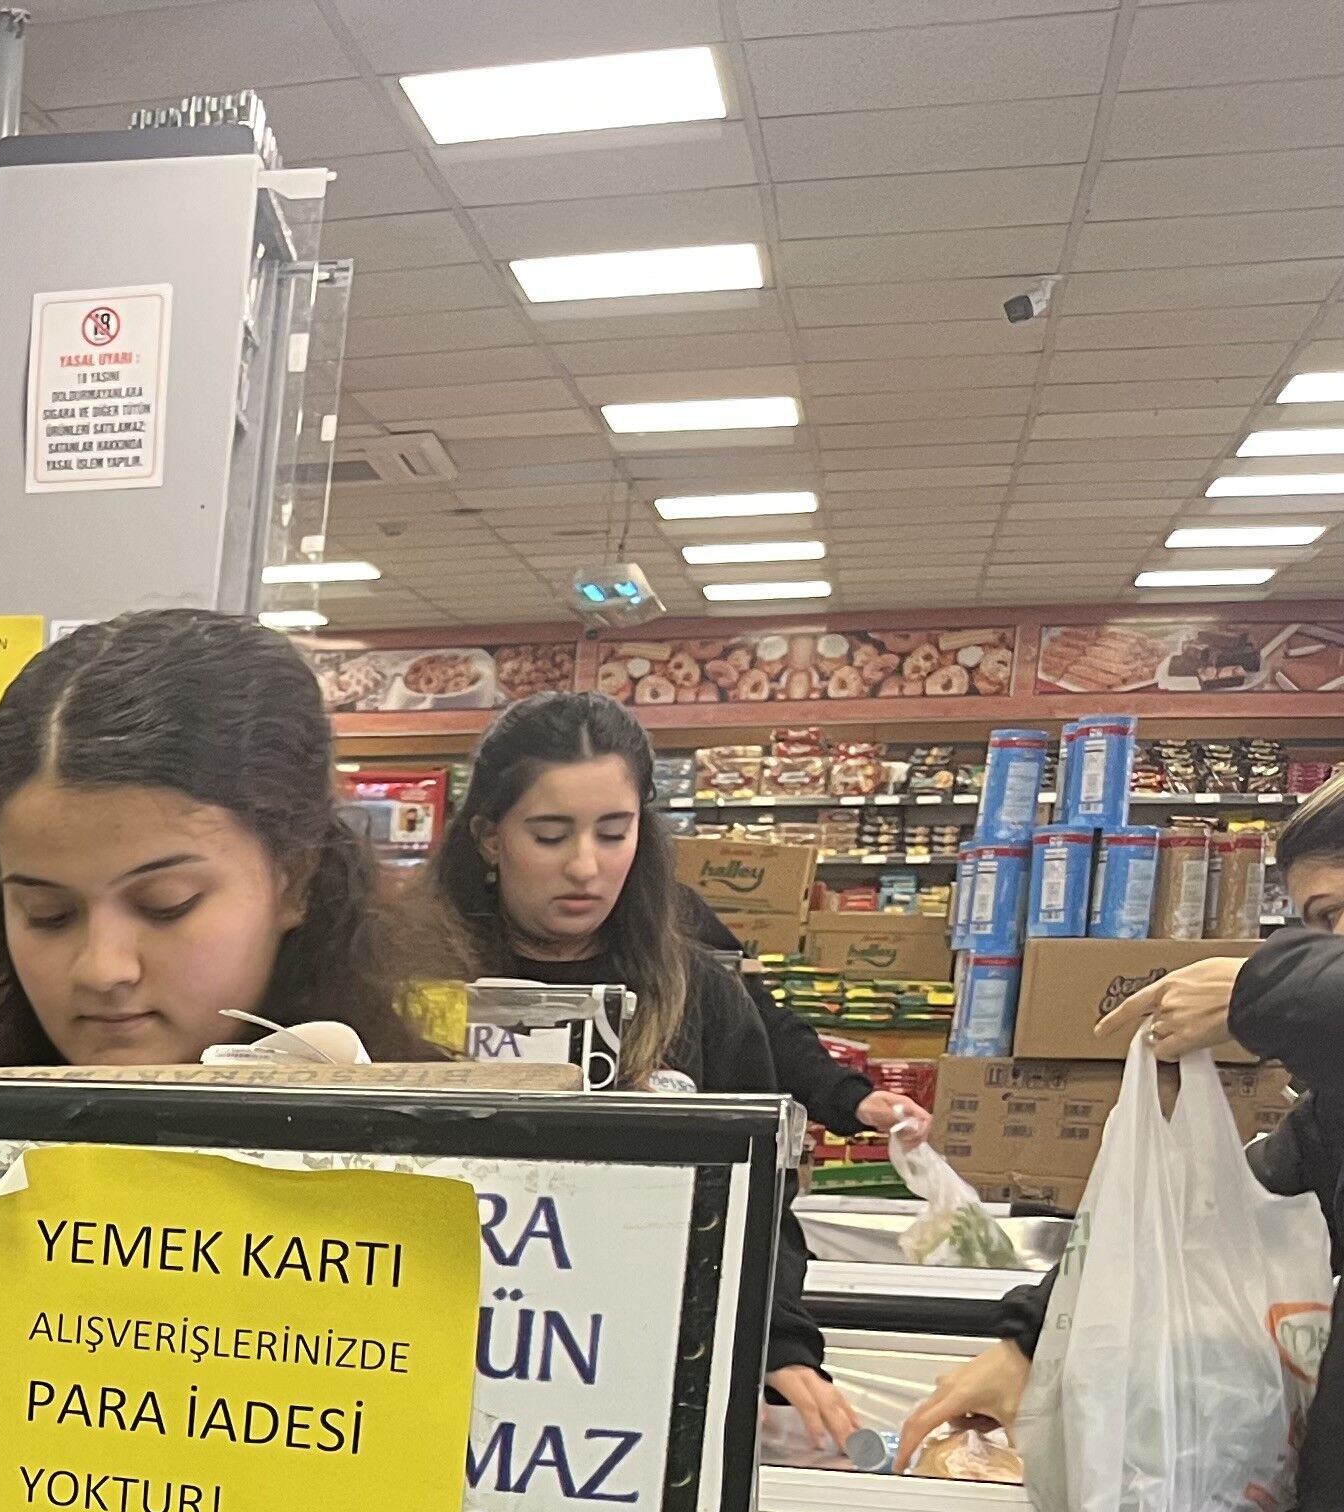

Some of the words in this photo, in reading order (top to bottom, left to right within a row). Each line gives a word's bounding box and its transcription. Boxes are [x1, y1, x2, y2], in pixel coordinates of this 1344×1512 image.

[59, 354, 95, 367] YASAL
[472, 1025, 521, 1058] RA
[36, 1218, 223, 1275] YEMEK
[242, 1232, 403, 1288] KARTI
[476, 1192, 573, 1270] RA
[28, 1311, 411, 1374] ALIŞVERİŞLERİNİZDE
[474, 1286, 603, 1385] ÜN
[26, 1379, 167, 1436] PARA
[186, 1384, 365, 1455] İADESİ
[465, 1421, 644, 1504] MAZ
